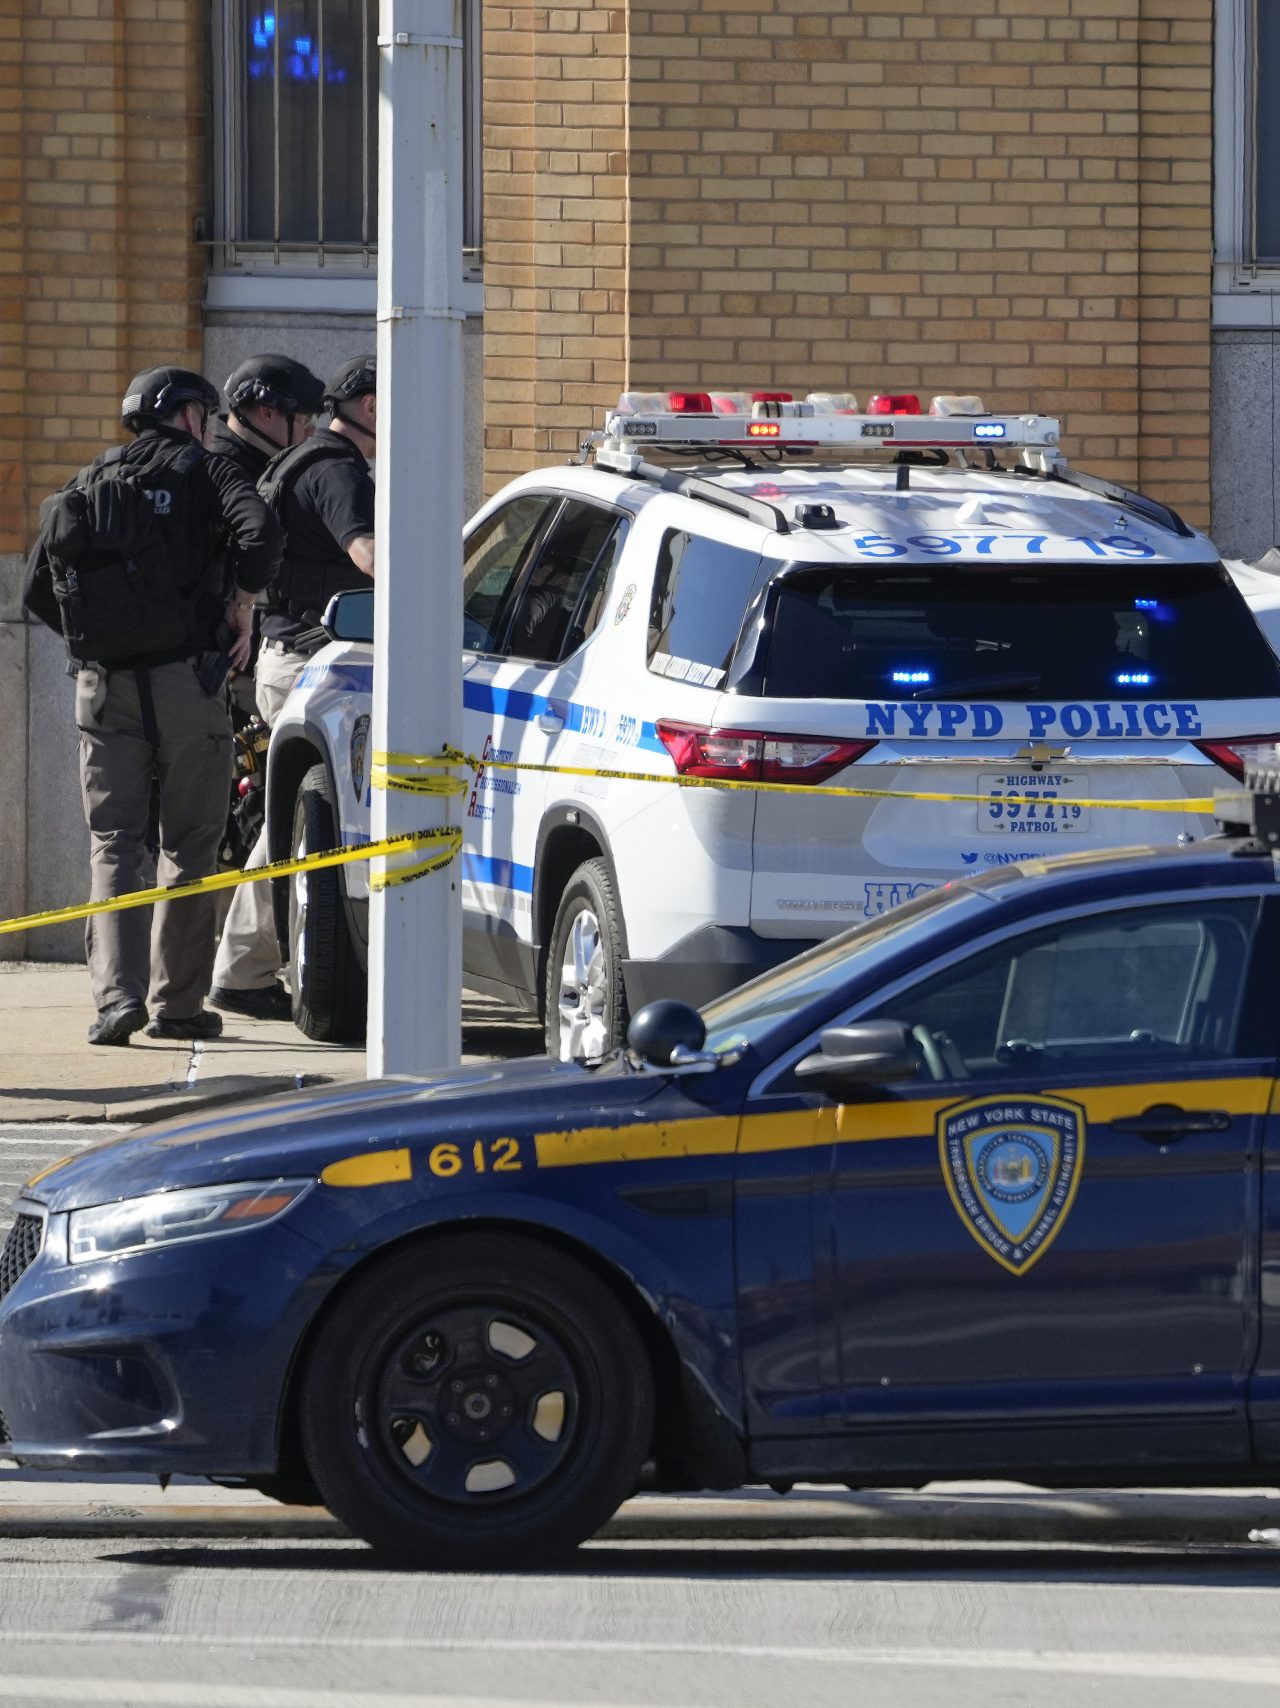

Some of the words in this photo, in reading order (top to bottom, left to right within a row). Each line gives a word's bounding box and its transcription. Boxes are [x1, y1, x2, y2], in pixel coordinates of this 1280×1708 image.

[853, 535, 1049, 558] 5977
[1065, 534, 1157, 558] 19
[866, 703, 1004, 738] NYPD
[1026, 703, 1202, 738] POLICE
[1006, 775, 1063, 786] HIGHWAY
[989, 790, 1058, 819] 5977
[1061, 805, 1082, 819] 19
[1010, 821, 1058, 833] PATROL
[948, 1113, 979, 1136] NEW
[984, 1107, 1026, 1123] YORK
[1030, 1107, 1074, 1130] STATE
[428, 1137, 523, 1177] 612
